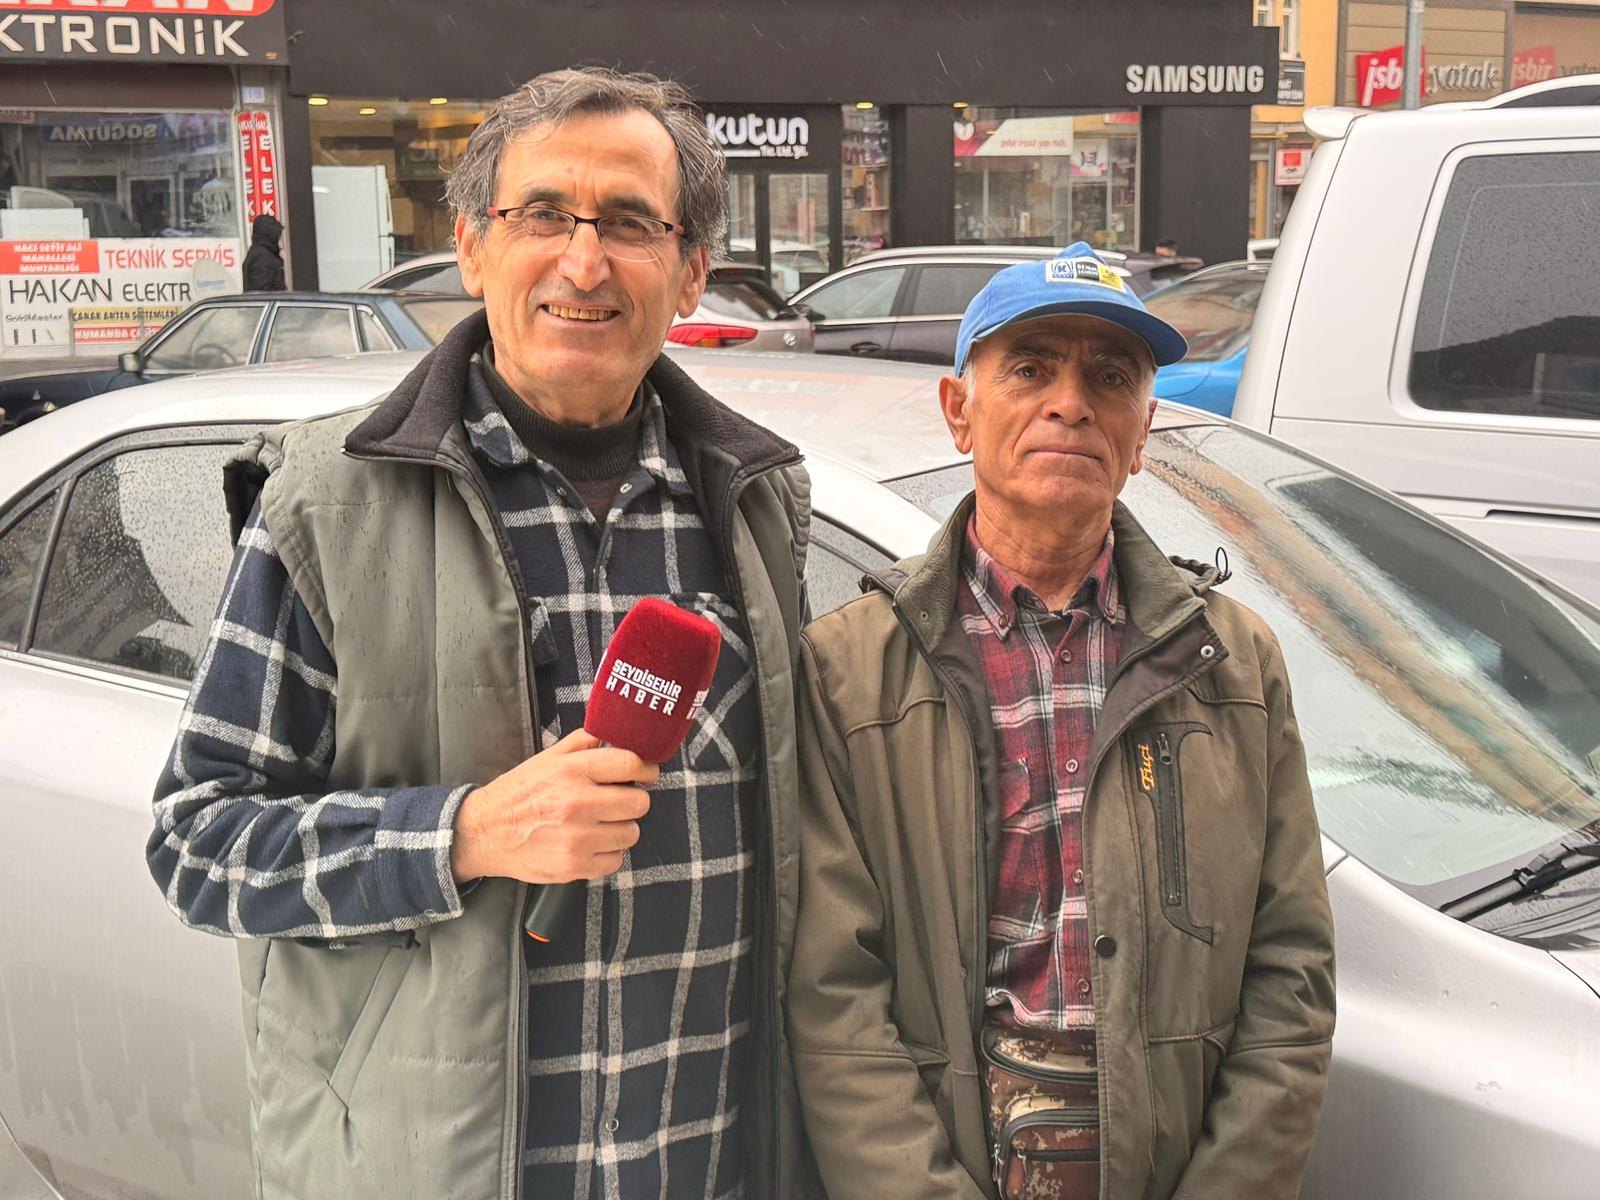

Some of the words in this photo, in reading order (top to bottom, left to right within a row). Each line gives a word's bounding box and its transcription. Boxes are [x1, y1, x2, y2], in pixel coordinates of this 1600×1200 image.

[1126, 64, 1265, 94] SAMSUNG
[105, 244, 167, 269] TEKNİK
[9, 278, 112, 304] HAKAN
[605, 676, 675, 716] HABER
